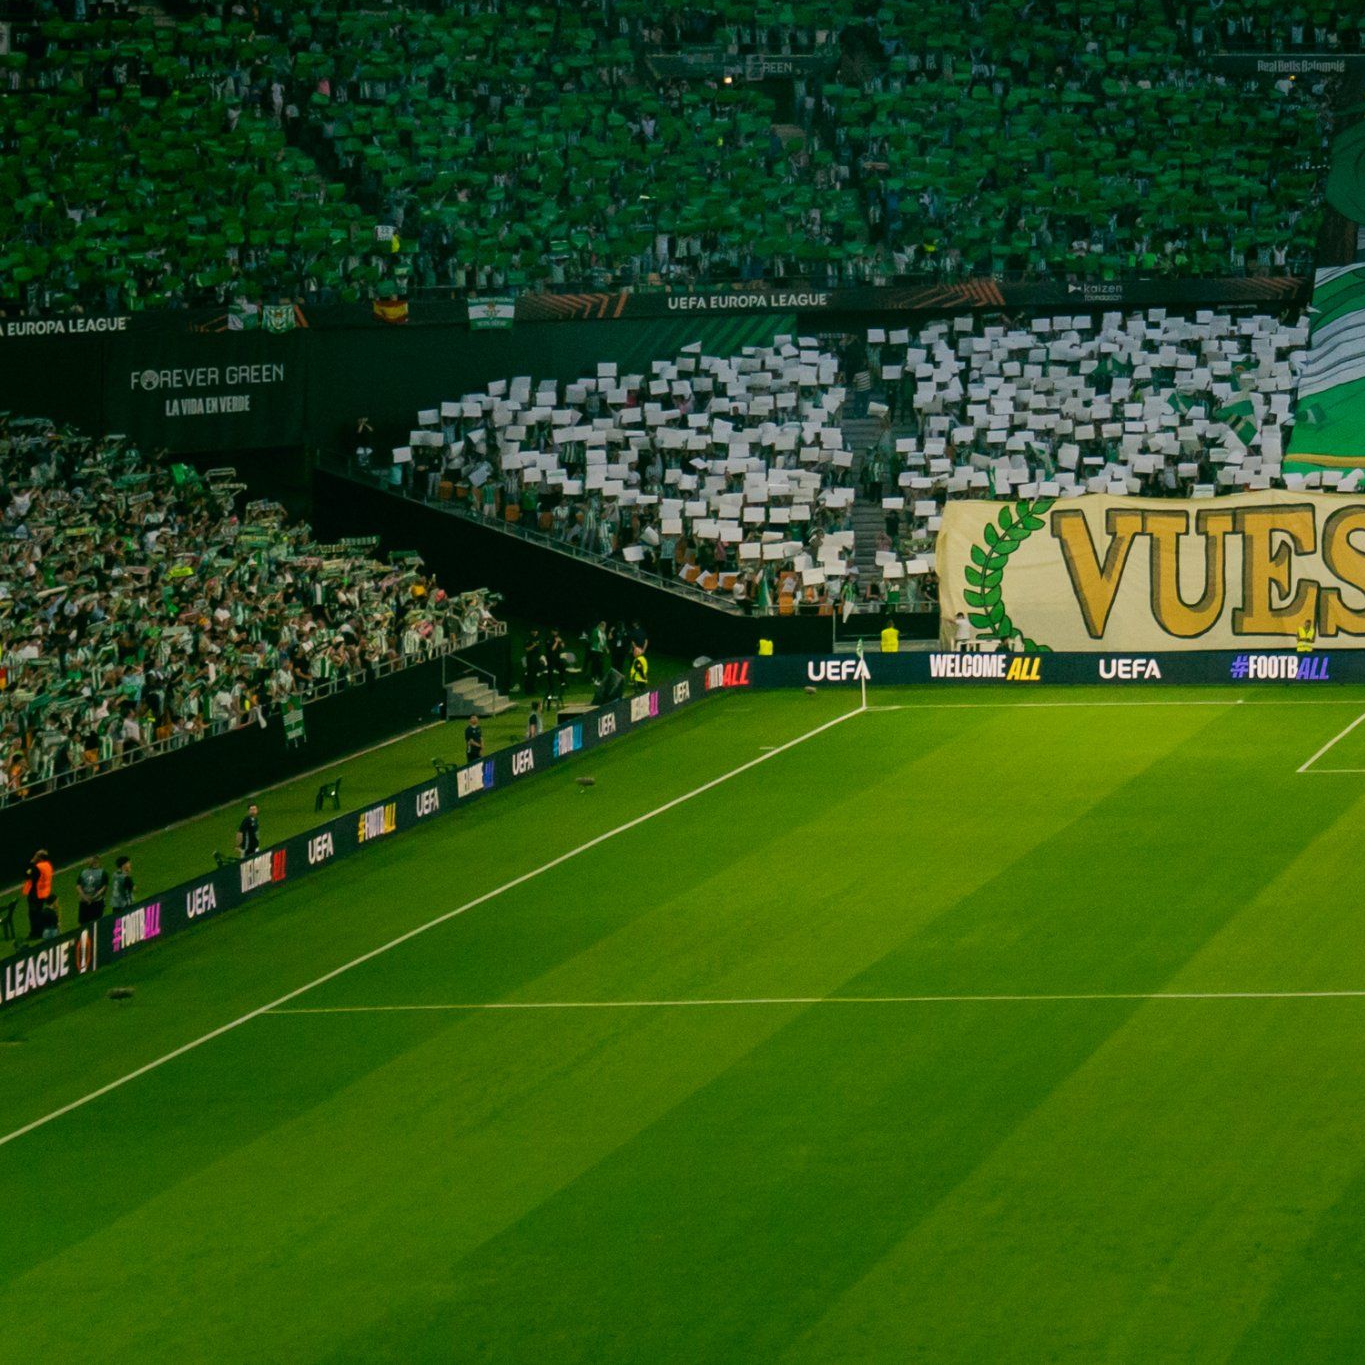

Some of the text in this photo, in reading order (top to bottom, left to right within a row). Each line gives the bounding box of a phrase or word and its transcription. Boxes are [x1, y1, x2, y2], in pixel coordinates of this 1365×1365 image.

[1084, 283, 1123, 294] kaizen
[668, 293, 827, 310] UEFA EUROPA LEAGUE
[7, 319, 65, 336] EUROPA
[69, 317, 127, 334] LEAGUE
[131, 364, 284, 390] FOREVER GREEN
[166, 395, 250, 416] LA VIDA EN VERDE
[807, 660, 871, 680] UEFA
[929, 654, 1041, 681] WELCOME ALL
[1099, 658, 1162, 679] UEFA
[1230, 655, 1329, 680] #FOOTBALL
[673, 680, 690, 705] UEFA
[598, 712, 616, 737] UEFA
[512, 748, 534, 776] UEFA
[416, 787, 439, 817] UEFA
[308, 832, 334, 865] UEFA
[186, 883, 216, 918] UEFA
[5, 940, 71, 1002] LEAGUE
